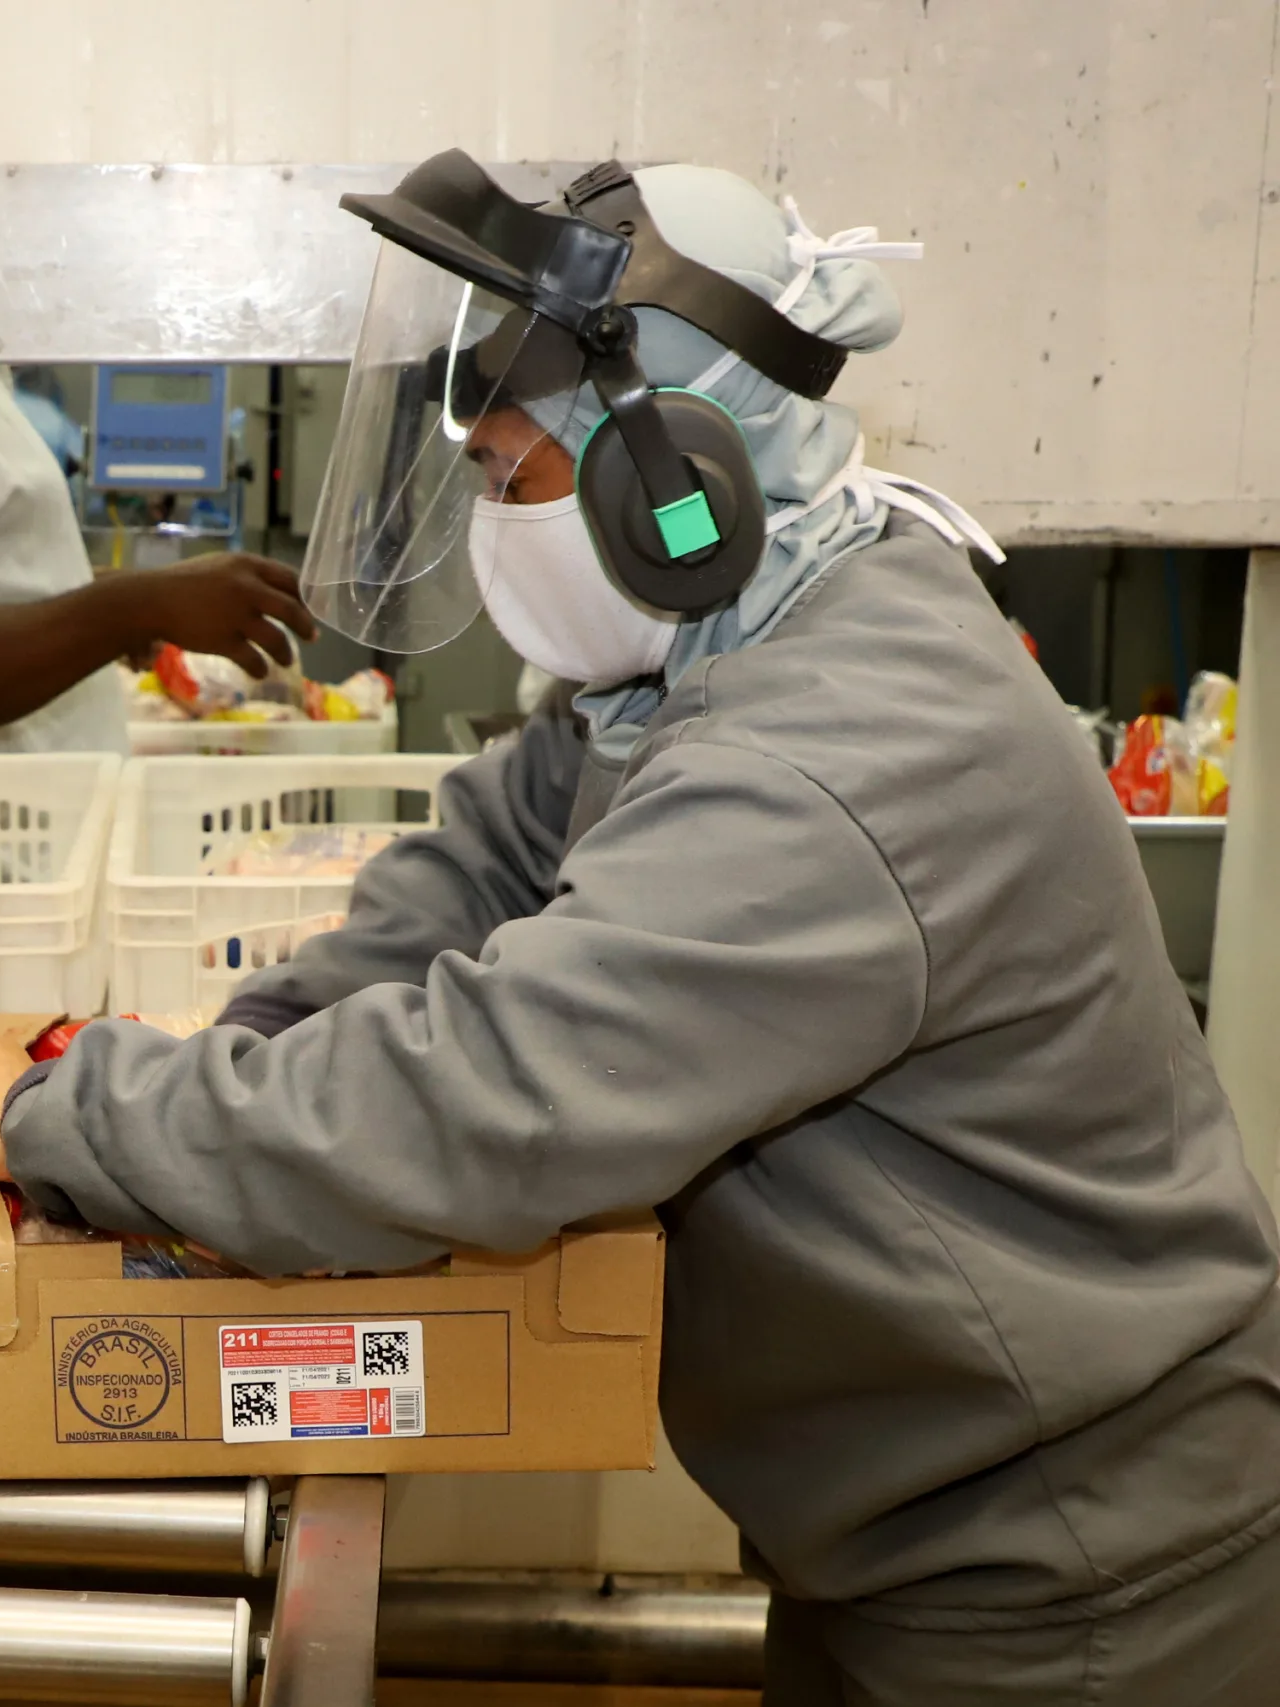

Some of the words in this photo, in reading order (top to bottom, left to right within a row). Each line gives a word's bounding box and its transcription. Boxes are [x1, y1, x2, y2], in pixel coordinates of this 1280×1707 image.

[224, 1332, 258, 1347] 211
[57, 1323, 98, 1388] MINISTÉRIO
[100, 1318, 119, 1330] DA
[122, 1318, 182, 1386] AGRICULTURA
[78, 1336, 156, 1369] BRASIL
[76, 1374, 164, 1386] INSPECIONADO
[336, 1368, 351, 1384] 0211
[103, 1388, 138, 1399] 2913
[100, 1404, 142, 1422] S.I.F.
[66, 1430, 118, 1441] INDÚSTRIA
[120, 1432, 179, 1440] BRASILEIRA
